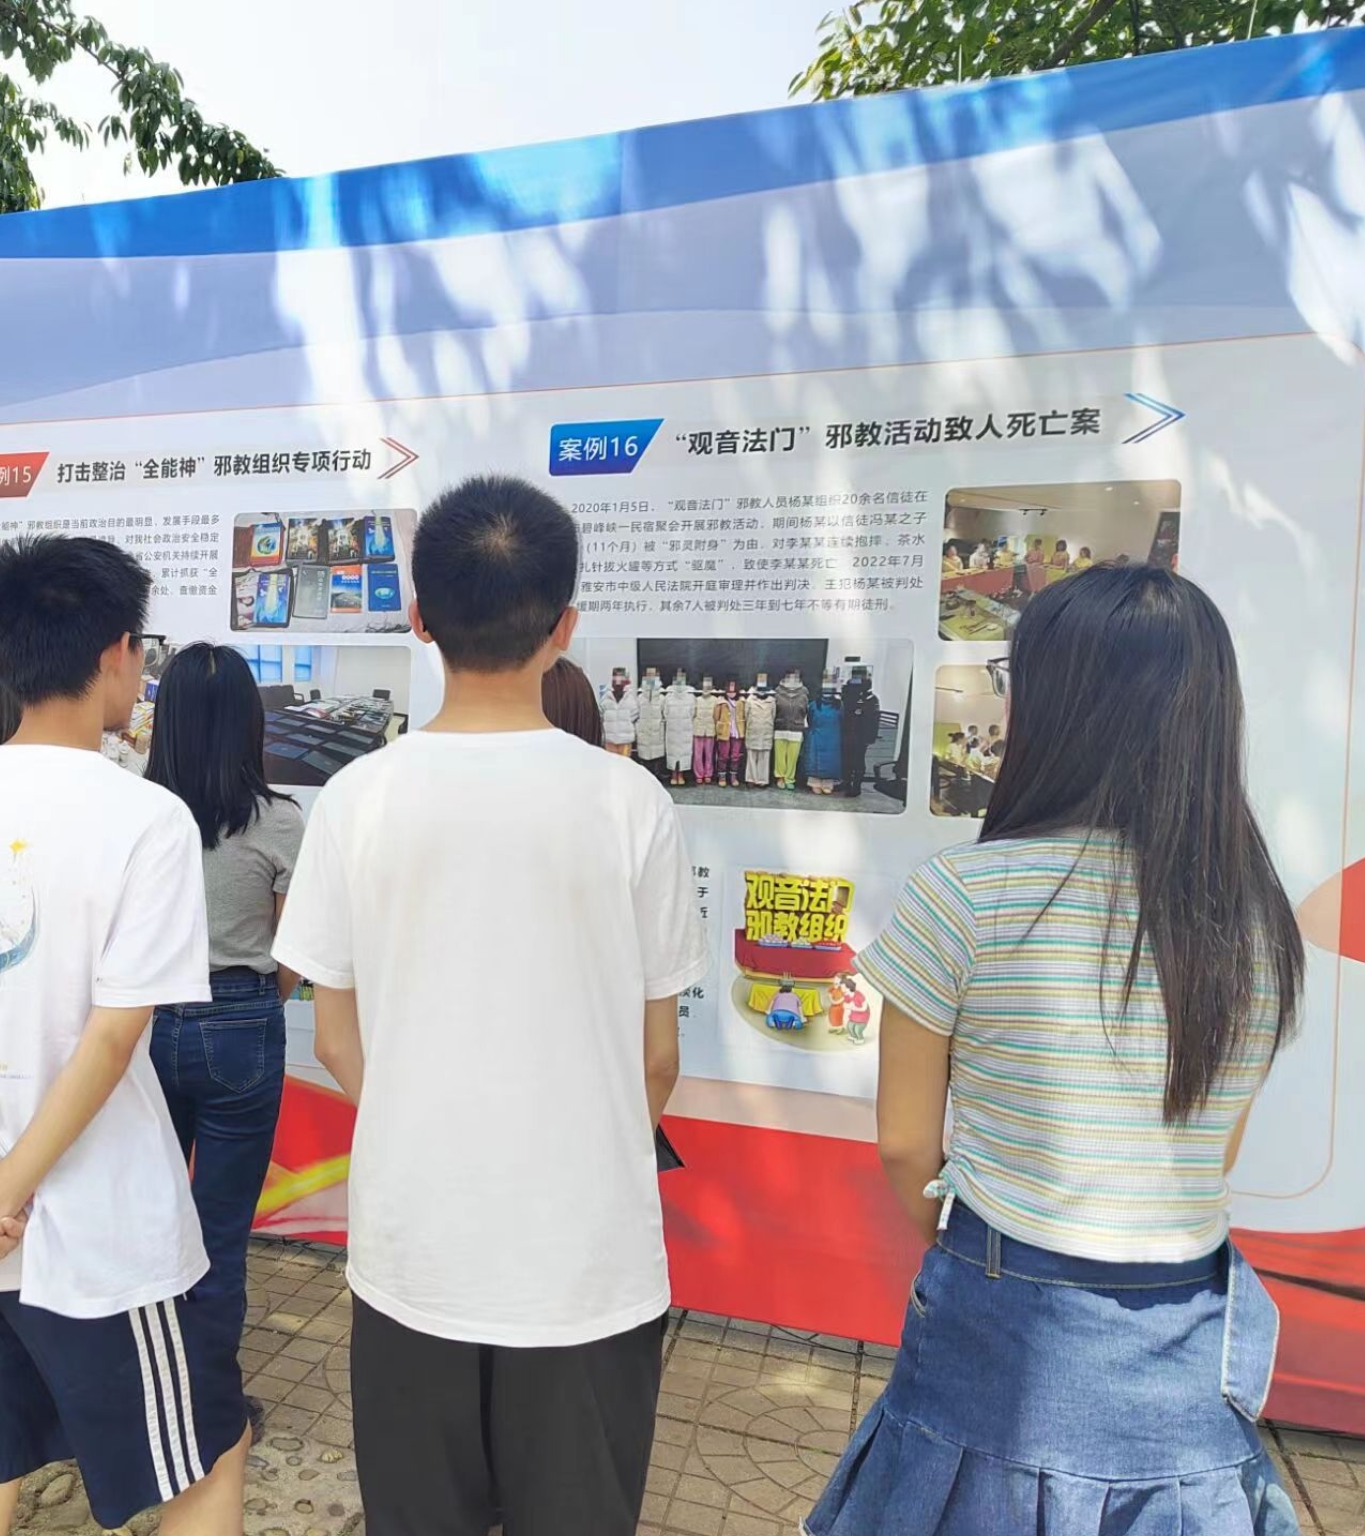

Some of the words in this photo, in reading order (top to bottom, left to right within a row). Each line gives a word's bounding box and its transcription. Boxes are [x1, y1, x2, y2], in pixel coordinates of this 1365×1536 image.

[558, 435, 639, 463] 案例16
[676, 408, 1101, 457] “观音法门”邪教活动致人死亡案
[57, 450, 371, 483] 打击整治“全能神”邪教组织专项行动
[745, 872, 855, 913] 观音法门
[746, 910, 849, 941] 邪教组织
